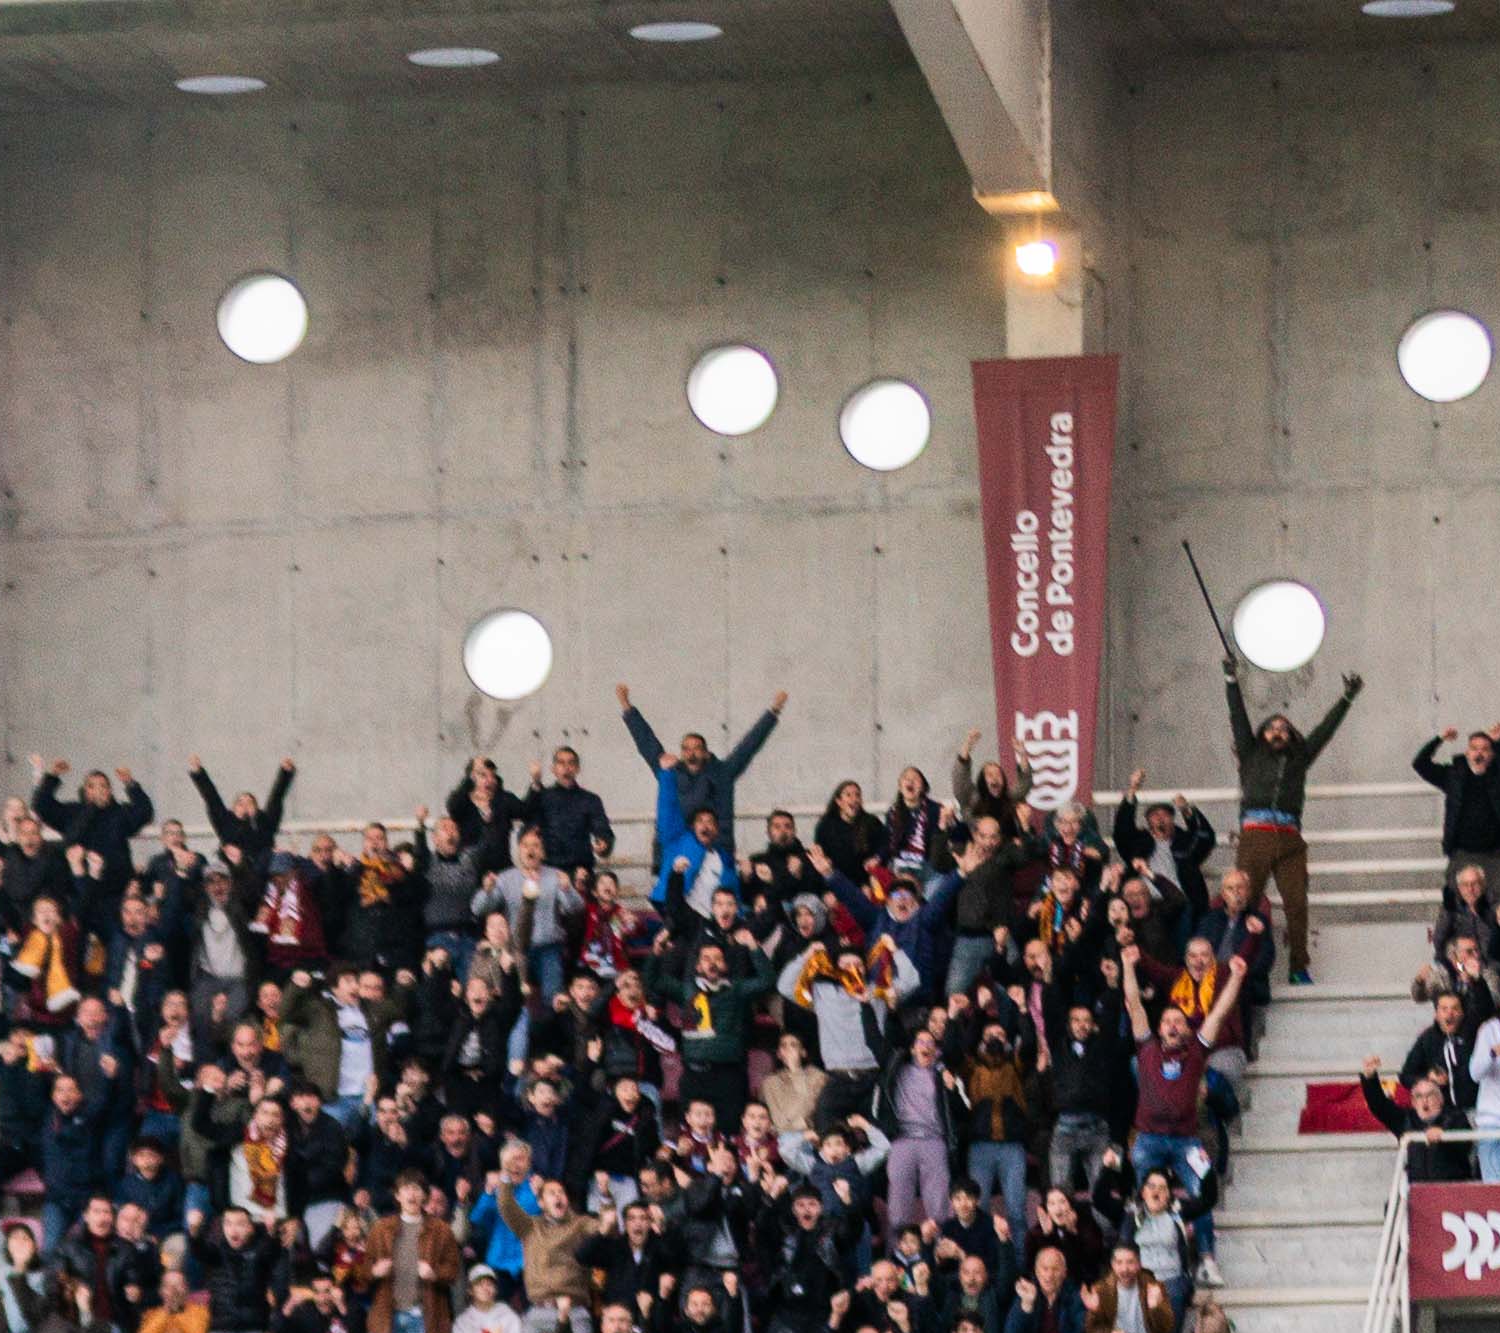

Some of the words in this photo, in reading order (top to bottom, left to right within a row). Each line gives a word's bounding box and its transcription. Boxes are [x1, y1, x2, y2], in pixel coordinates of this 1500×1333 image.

[1010, 509, 1040, 656] Concello
[1045, 411, 1073, 607] Pontevedra
[1045, 612, 1074, 656] de
